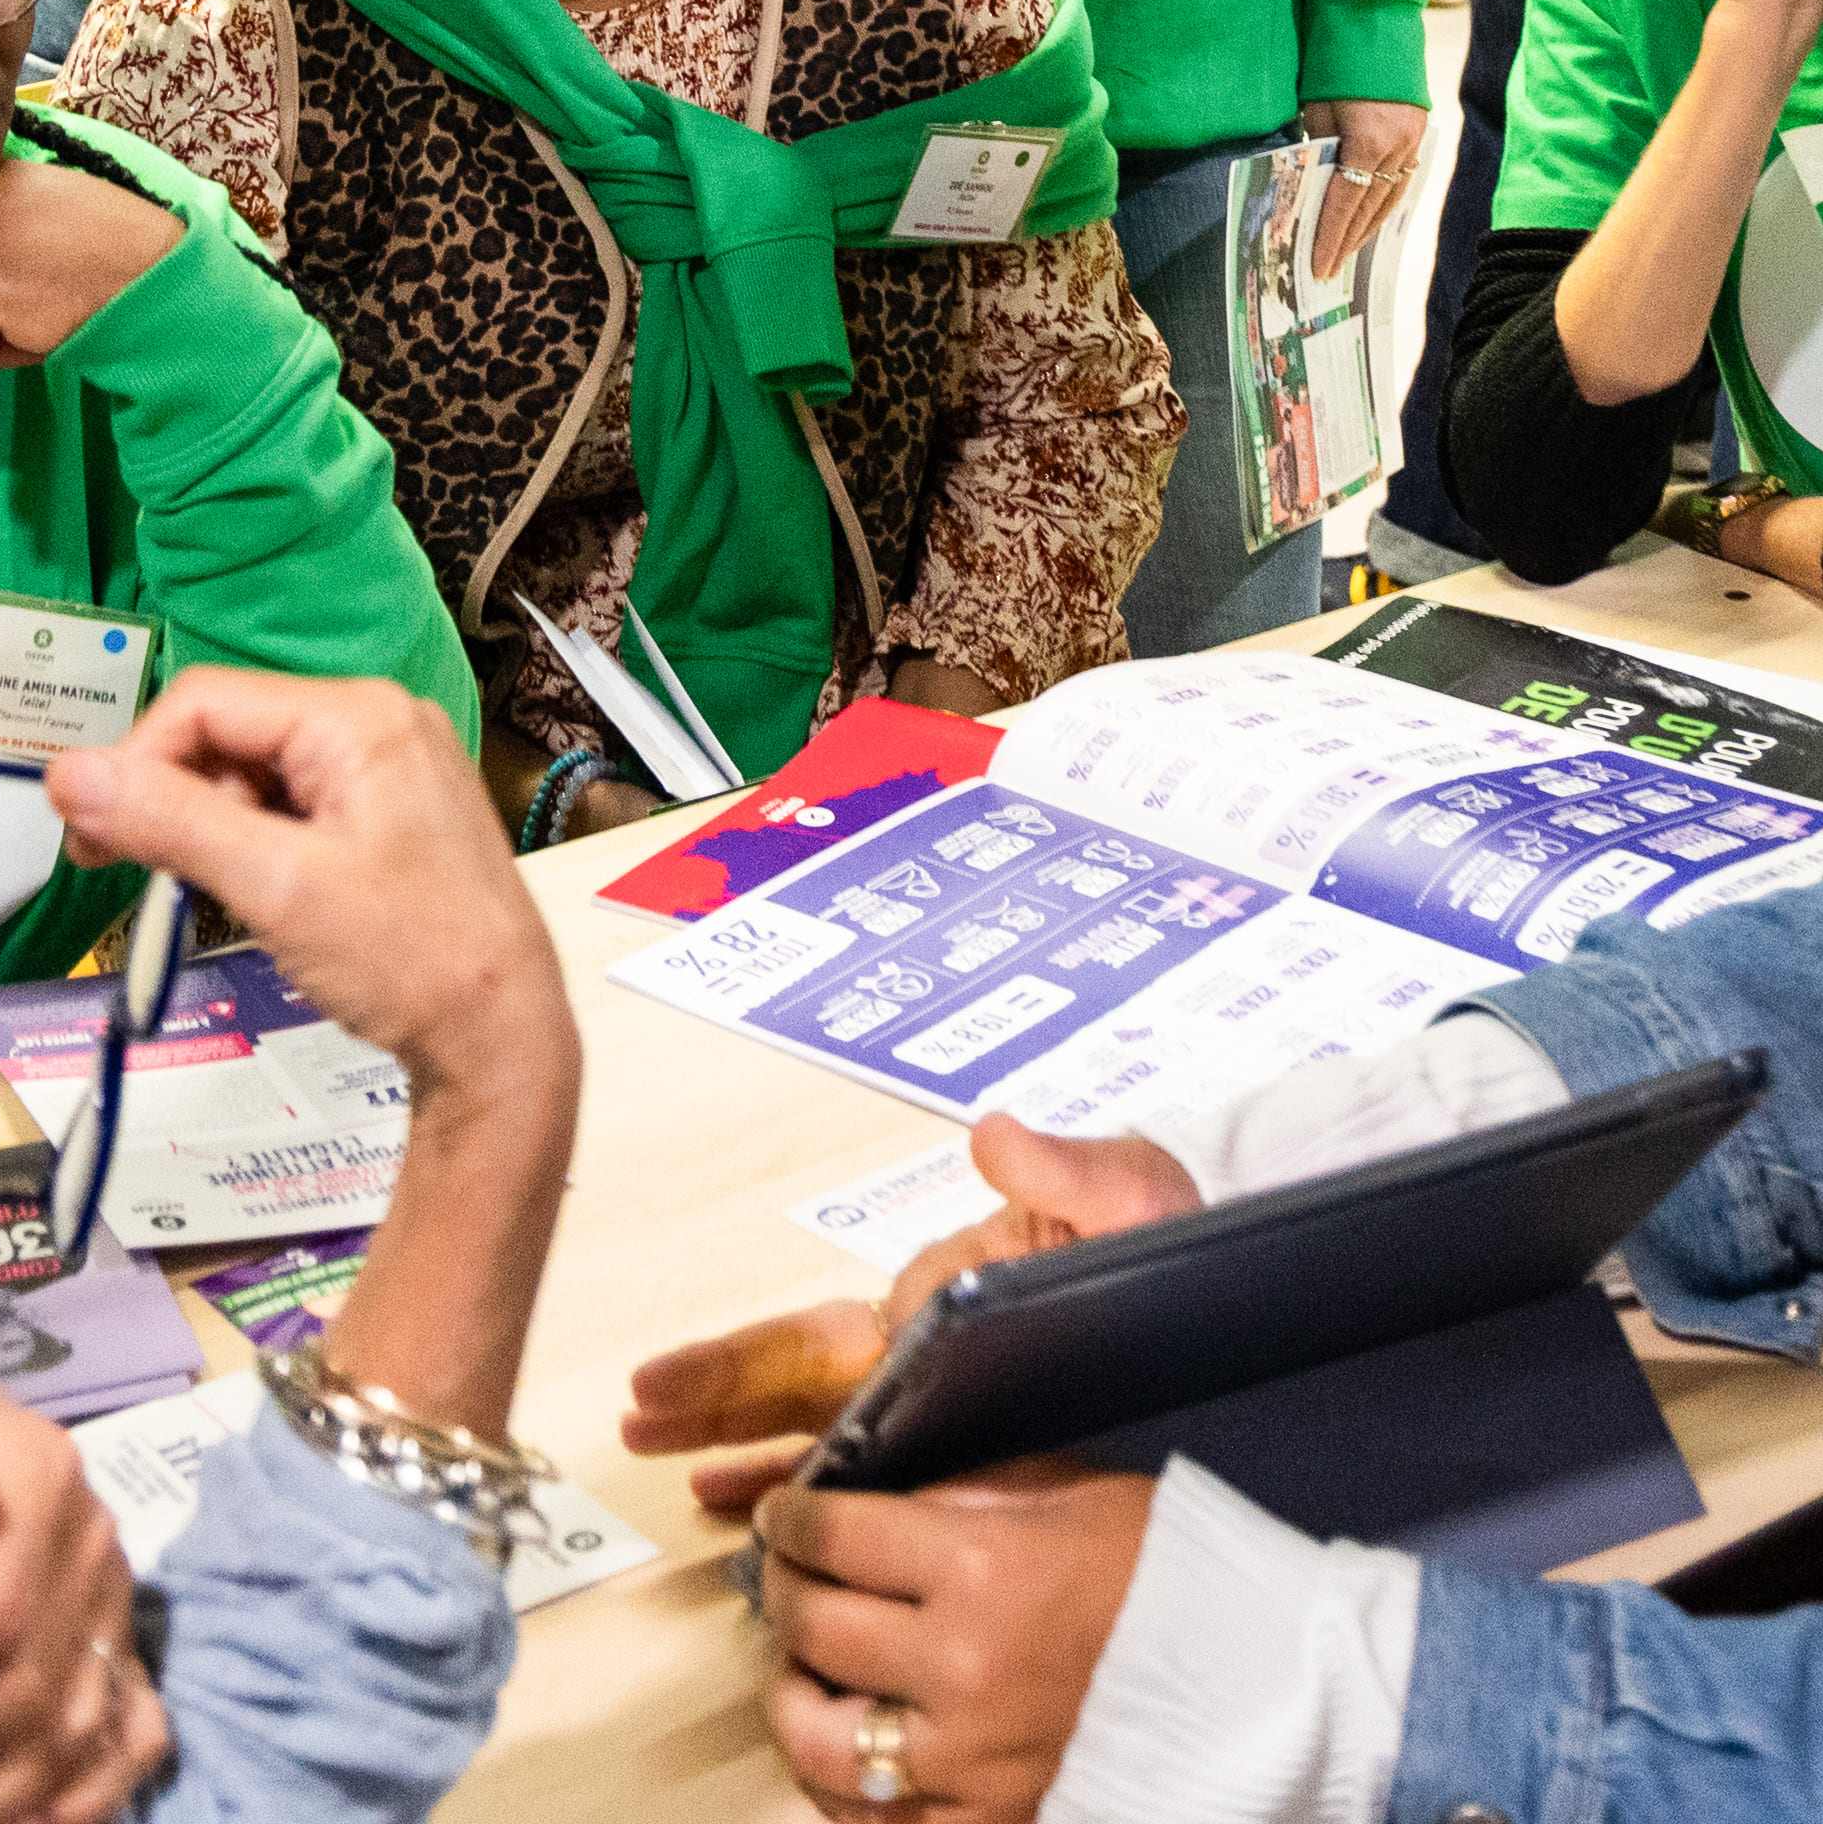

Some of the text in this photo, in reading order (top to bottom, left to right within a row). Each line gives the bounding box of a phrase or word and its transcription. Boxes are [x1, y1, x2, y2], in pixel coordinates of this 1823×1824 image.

[22, 680, 57, 695] AMISI
[59, 686, 117, 704] MATENDA
[654, 918, 787, 980] 28 %
